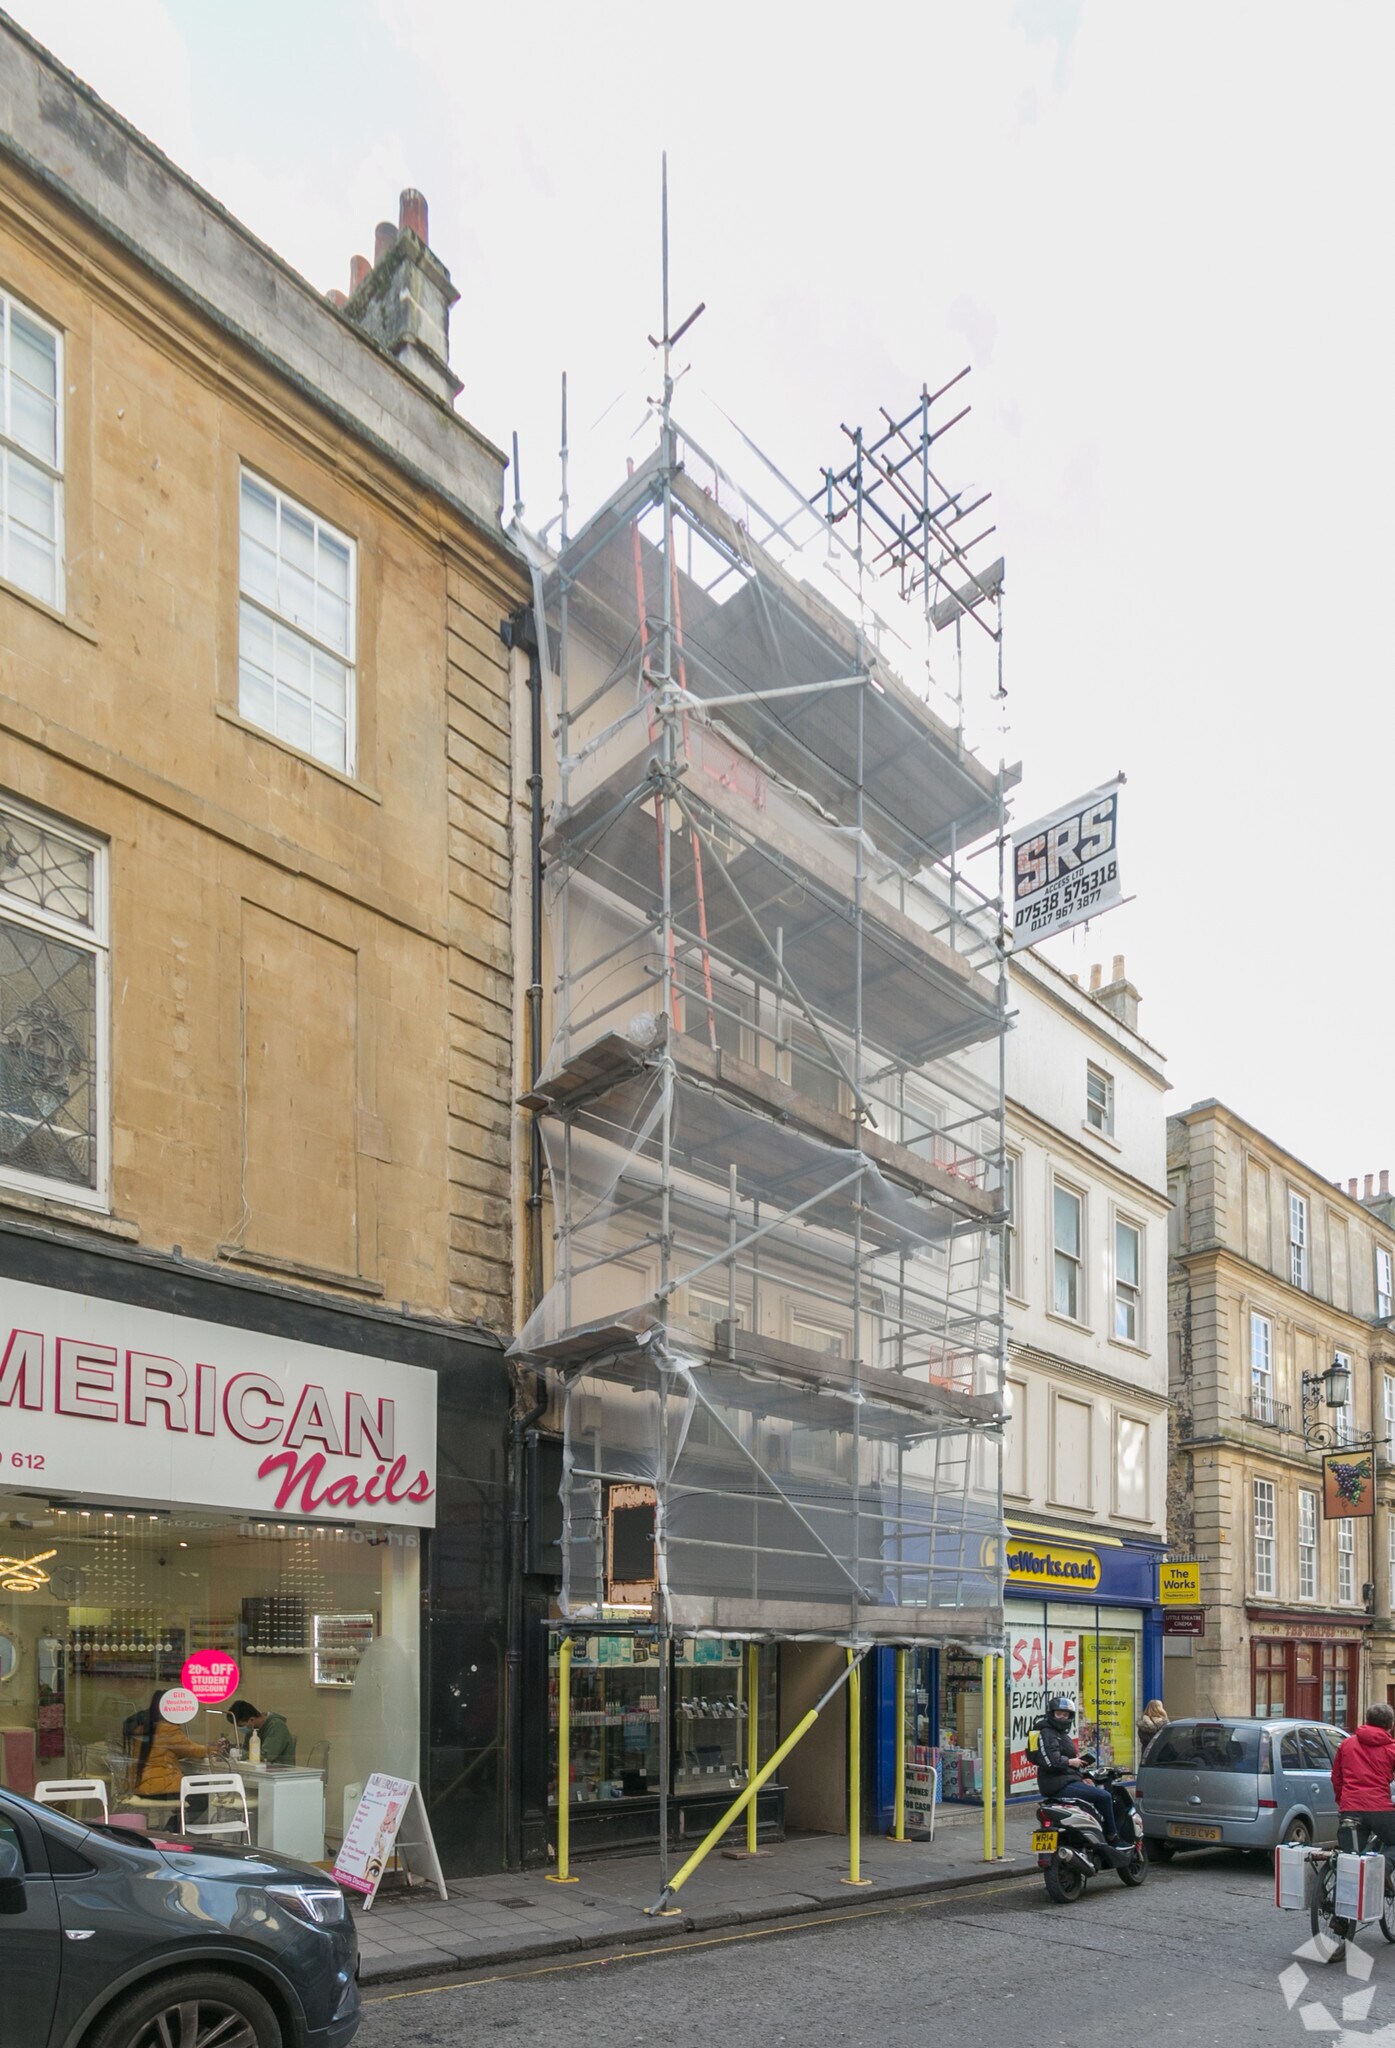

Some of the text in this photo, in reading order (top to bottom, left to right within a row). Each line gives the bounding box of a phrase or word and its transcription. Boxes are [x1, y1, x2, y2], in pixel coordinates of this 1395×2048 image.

[1017, 798, 1113, 896] SRS
[1044, 867, 1085, 896] ACCESS LTD
[1015, 860, 1117, 927] 07538 575318
[1030, 913, 1053, 932] 0117
[1055, 903, 1074, 920] 967
[1076, 889, 1101, 911] 3877
[11, 1452, 45, 1470] 612
[258, 1451, 435, 1513] Nails
[1006, 1550, 1096, 1579] eWorks.co.uk
[1170, 1569, 1189, 1578] The
[1164, 1579, 1196, 1589] Works
[1013, 1637, 1077, 1686] SALE
[188, 1663, 235, 1675] 20% OFF
[191, 1675, 230, 1685] STUDENT
[193, 1684, 228, 1693] DISCOUNT
[173, 1691, 186, 1699] Gift
[1091, 1699, 1126, 1707] Sationery
[916, 1773, 930, 1783] BUY
[905, 1785, 929, 1797] PHONES
[915, 1803, 931, 1812] CASH
[1035, 1833, 1054, 1842] WR14
[1198, 1828, 1216, 1839] CVS
[1036, 1842, 1052, 1851] CAA
